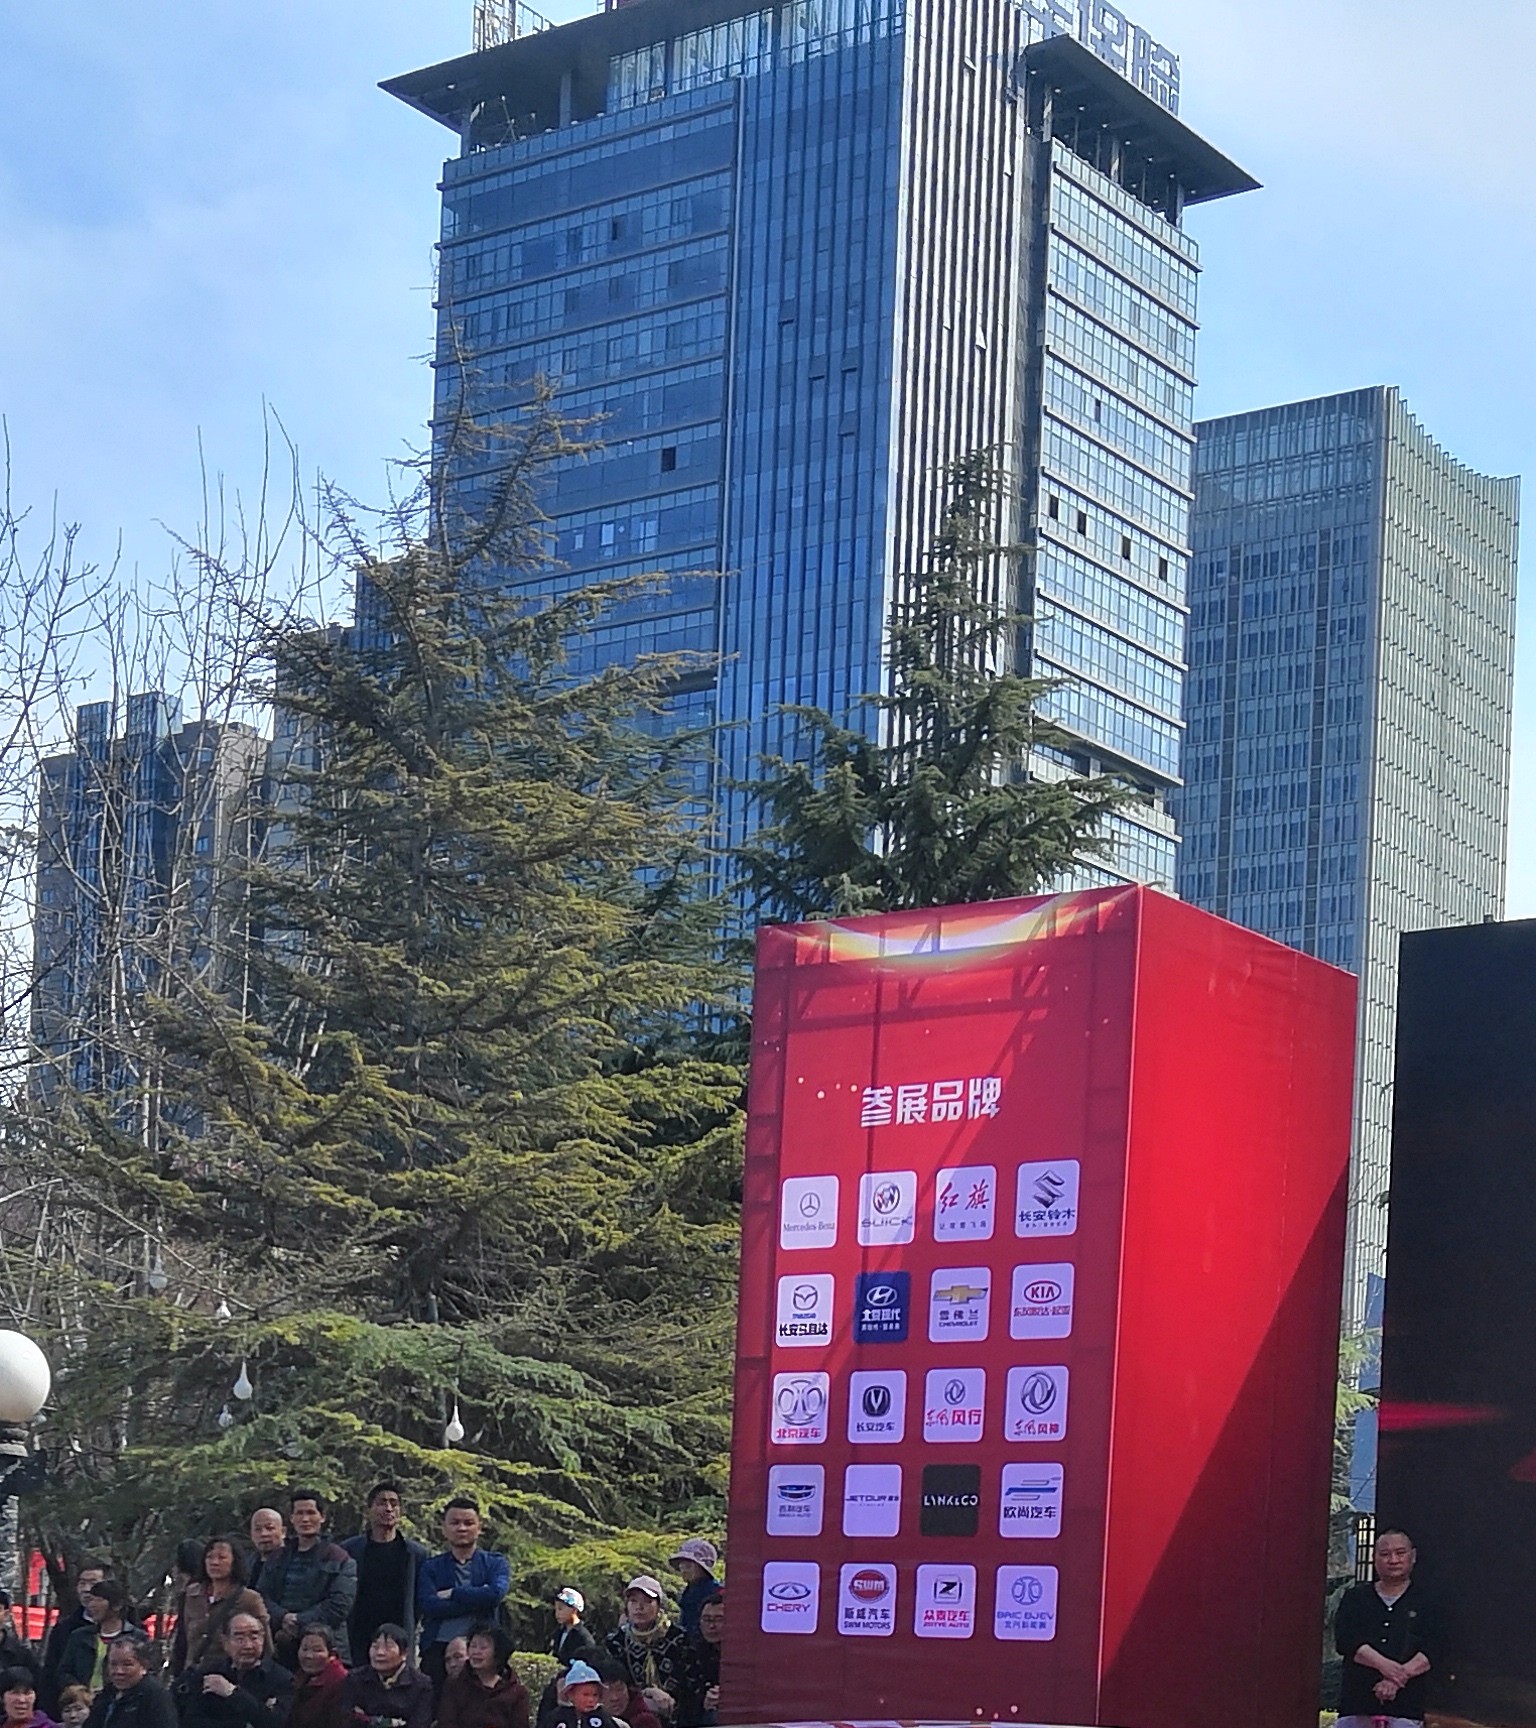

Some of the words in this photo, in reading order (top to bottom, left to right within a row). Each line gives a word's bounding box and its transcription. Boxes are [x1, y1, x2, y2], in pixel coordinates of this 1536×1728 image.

[861, 1077, 1001, 1127] 参展品牌
[940, 1179, 990, 1214] 红旗
[1019, 1208, 1075, 1222] 长安铃木
[1031, 1286, 1054, 1298] KIA
[861, 1308, 901, 1322] 北京现代
[939, 1309, 979, 1321] 雪佛兰
[779, 1323, 828, 1336] 长安马自达
[776, 1428, 821, 1439] 北京汽车
[856, 1422, 895, 1433] 长安汽车
[1004, 1506, 1056, 1519] 欧尚汽车
[854, 1578, 885, 1591] SWM
[767, 1602, 811, 1613] CHERY
[844, 1608, 891, 1620] 斯威汽车
[844, 1621, 860, 1629] SWM
[862, 1621, 891, 1630] MOTORS
